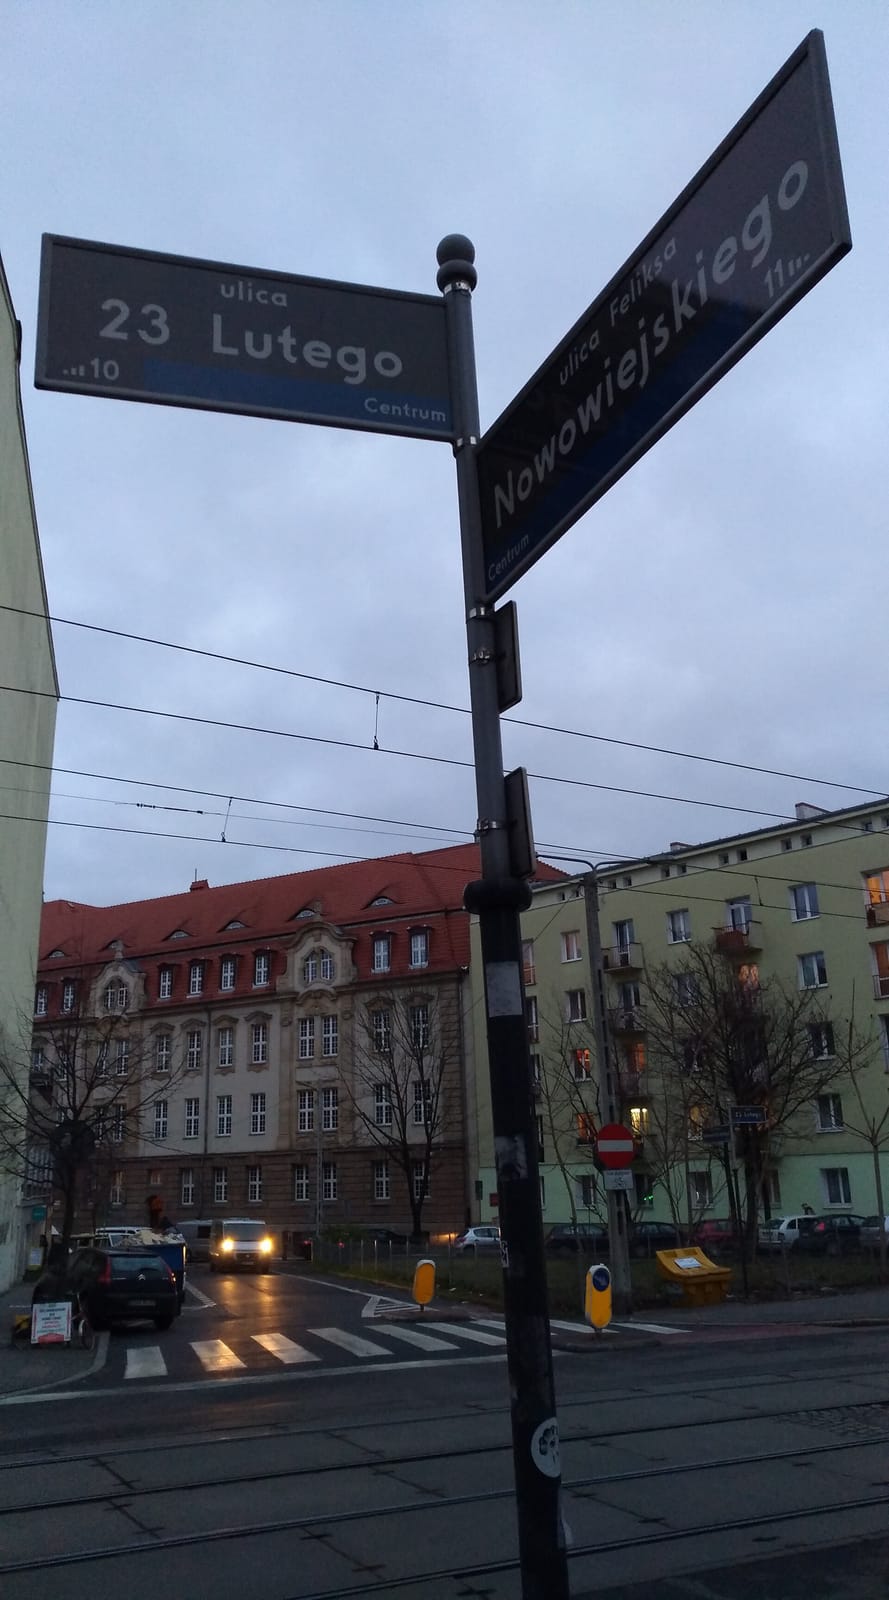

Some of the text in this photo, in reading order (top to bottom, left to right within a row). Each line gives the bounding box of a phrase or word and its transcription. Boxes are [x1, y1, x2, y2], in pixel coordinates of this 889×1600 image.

[220, 280, 288, 308] ulica
[763, 258, 785, 299] 11
[559, 237, 677, 386] ulica Feliksa
[99, 297, 404, 385] 23 Lutego
[493, 159, 809, 529] Nowowiejskiego
[91, 357, 120, 382] 10
[363, 397, 447, 423] Centrum
[488, 533, 529, 582] Centrum
